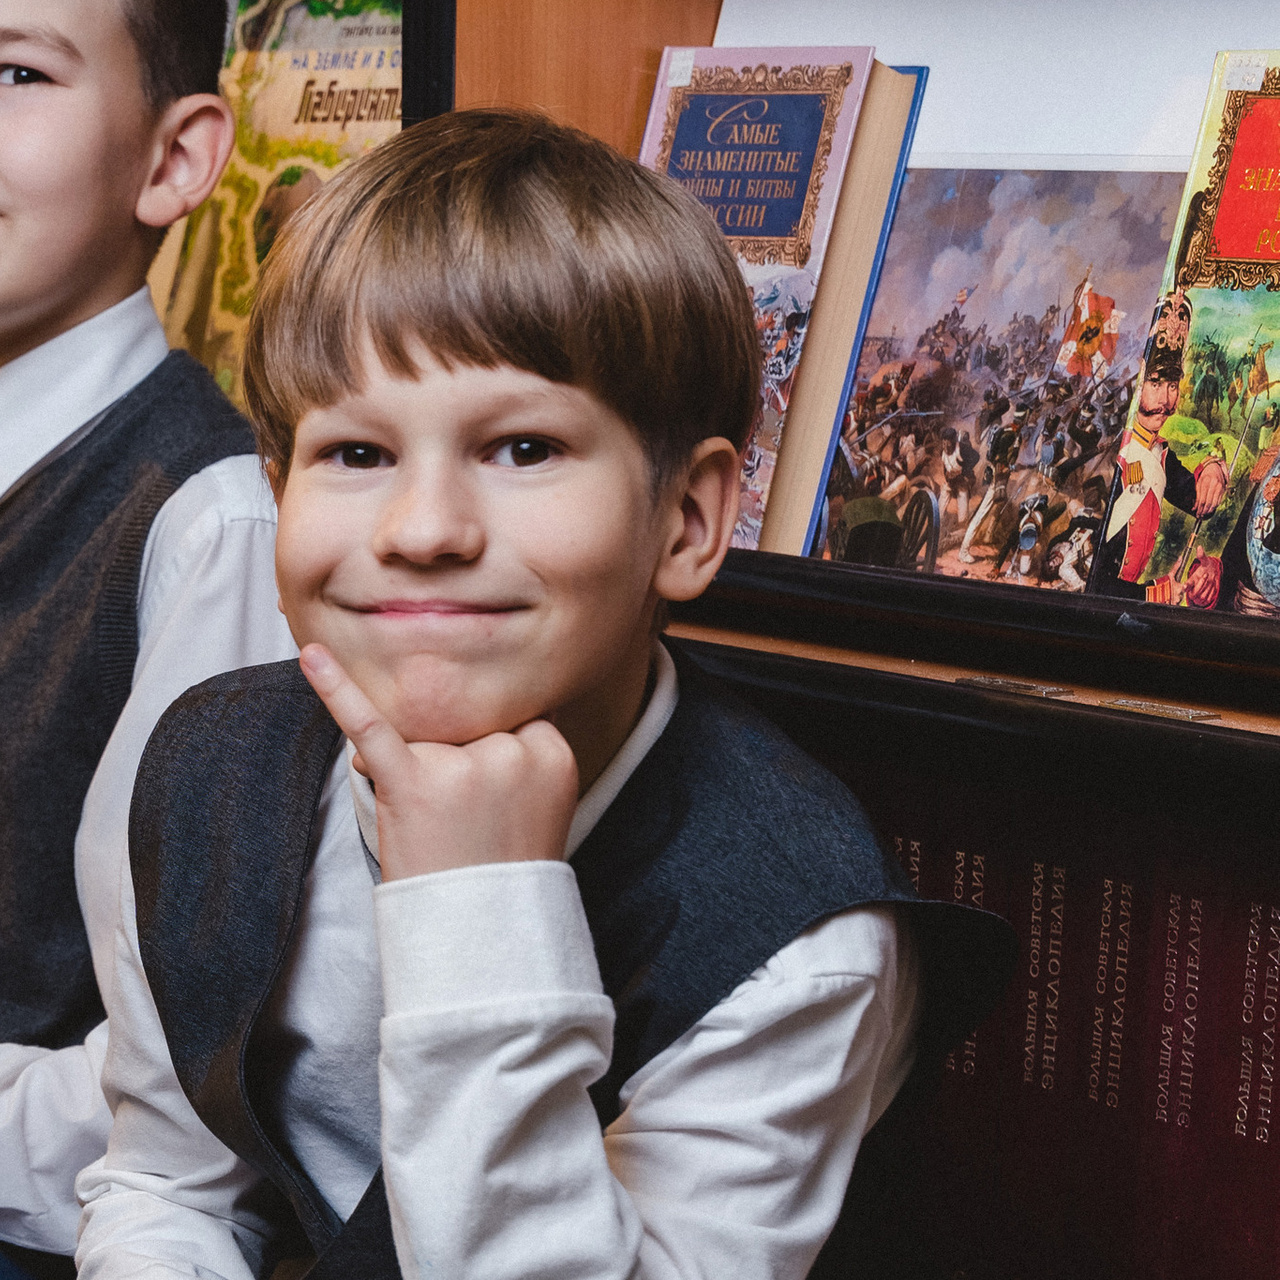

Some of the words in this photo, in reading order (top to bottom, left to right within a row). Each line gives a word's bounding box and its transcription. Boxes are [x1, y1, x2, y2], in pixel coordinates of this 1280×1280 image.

[674, 171, 725, 198] ОЙНЫ
[728, 178, 741, 198] И
[745, 178, 797, 199] БИТВЫ
[679, 150, 802, 173] ЗНАМЕНИТЫЕ
[1030, 862, 1045, 979] СОВЕТСКАЯ
[1041, 866, 1066, 1091] ЭНЦИКЛОПЕДИЯ
[1096, 878, 1113, 995] СОВЕТСКАЯ
[1163, 892, 1181, 1013] СОВЕТСКАЯ
[1242, 901, 1262, 1025] СОВЕТСКАЯ
[1024, 989, 1039, 1083] БОЛЬШАЯ
[1089, 1006, 1105, 1103] БОЛЬШАЯ
[1106, 883, 1132, 1109] ЭНЦИКЛОПЕДИЯ
[1177, 898, 1202, 1129] ЭНЦИКЛОПЕДИЯ
[1156, 1023, 1173, 1123] БОЛЬШАЯ
[1235, 1036, 1253, 1138] БОЛЬШАЯ
